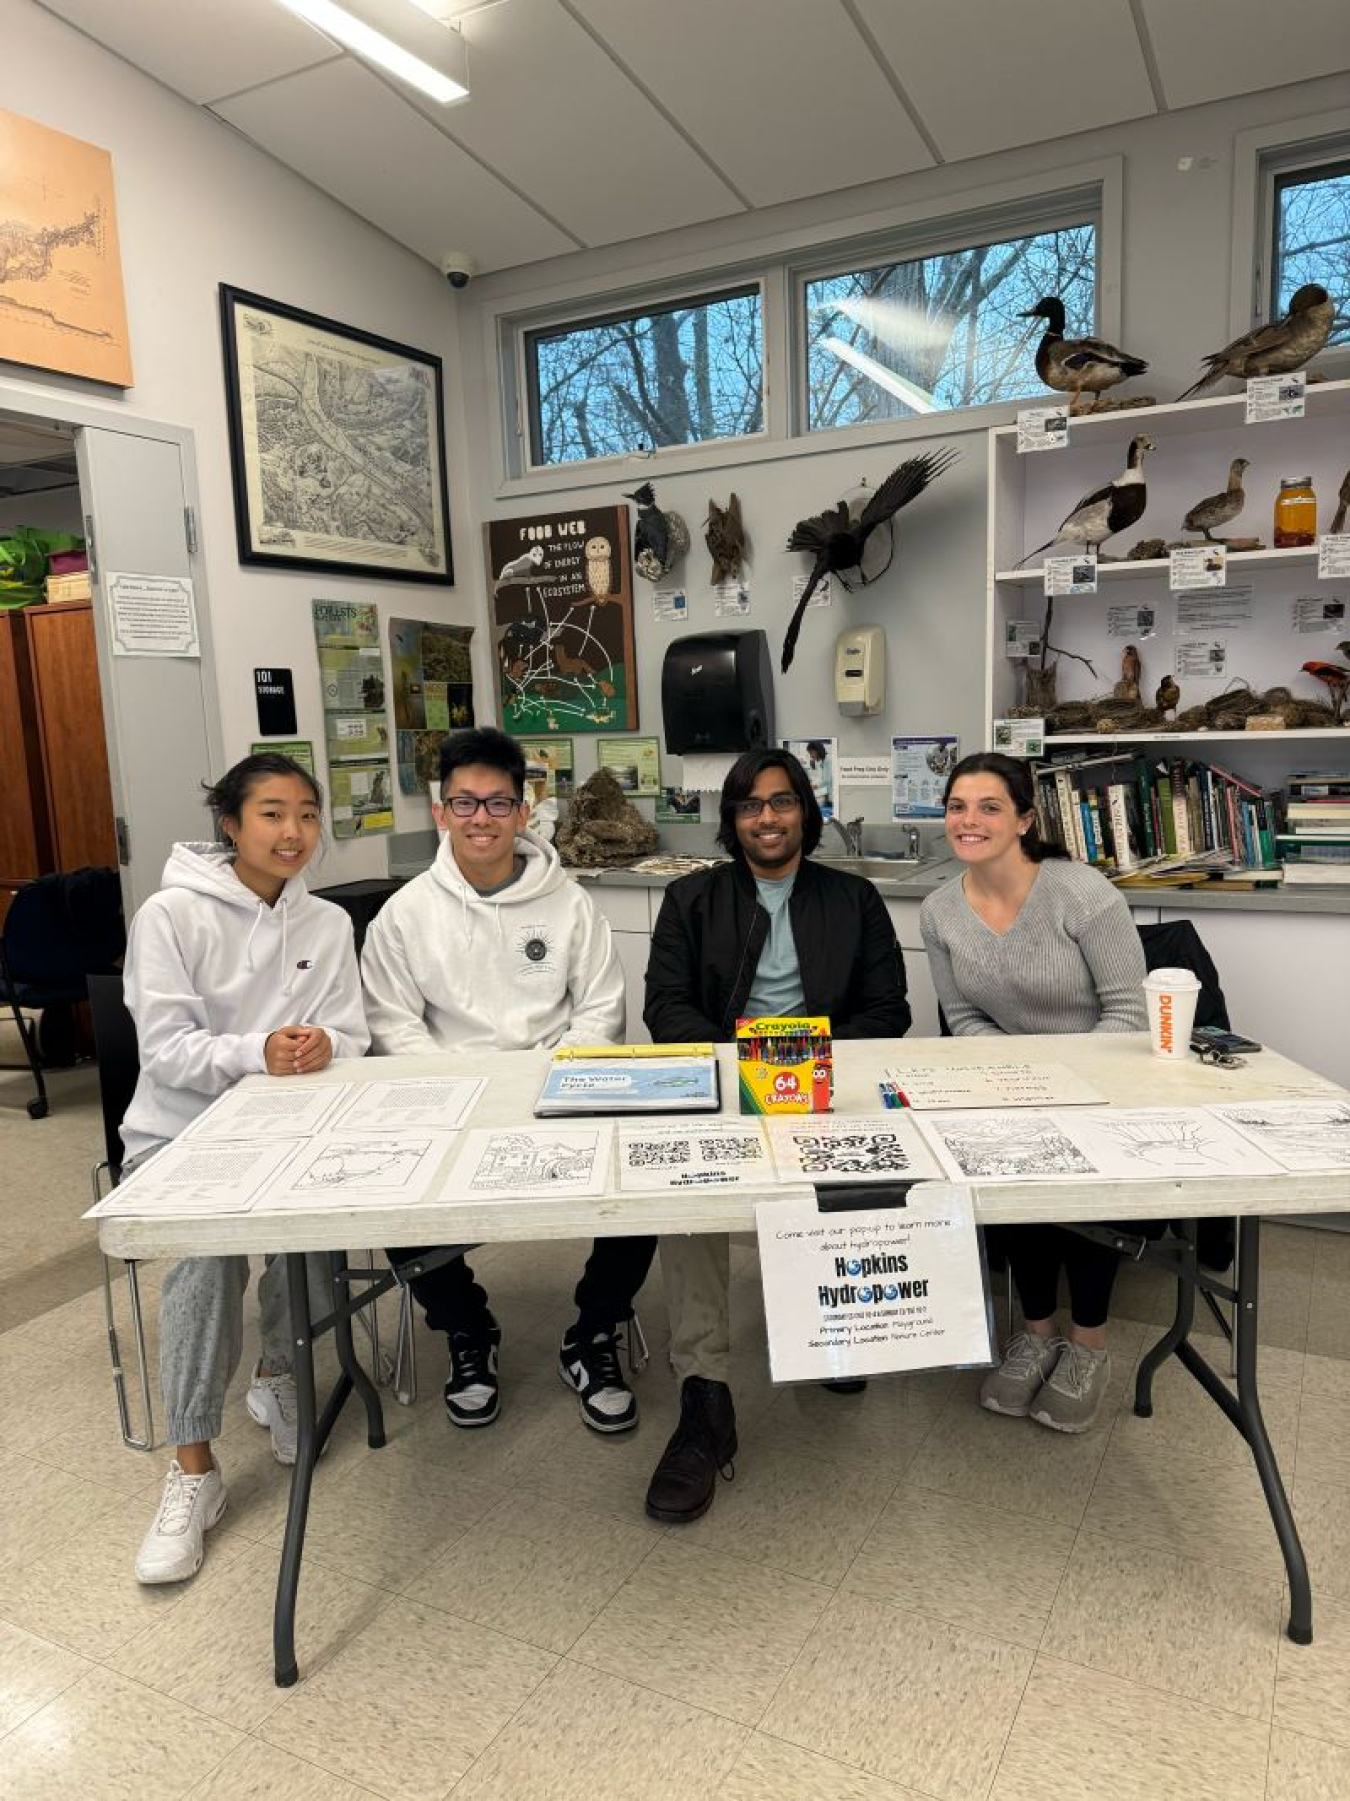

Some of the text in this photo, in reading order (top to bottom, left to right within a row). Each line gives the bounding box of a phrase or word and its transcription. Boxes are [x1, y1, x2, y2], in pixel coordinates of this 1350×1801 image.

[520, 520, 586, 540] FOOD WEB
[548, 540, 584, 553] THE FLOW
[542, 584, 585, 598] ECOSYSTEM
[256, 671, 272, 682] 101
[756, 1023, 810, 1033] Crayola
[1160, 995, 1173, 1054] DUNKIN'
[775, 1076, 797, 1091] 64
[776, 1230, 803, 1240] Come
[808, 1228, 825, 1237] visit
[829, 1228, 846, 1236] our
[885, 1223, 895, 1231] to
[898, 1221, 922, 1230] learn
[924, 1219, 951, 1227] more
[819, 1233, 911, 1251] about hydropower!
[835, 1252, 908, 1278] Hopkins
[818, 1279, 929, 1308] Hydropower
[819, 1325, 852, 1335] Primary
[892, 1318, 933, 1331] Playground
[808, 1336, 850, 1348] Secondary
[920, 1329, 945, 1338] Center
